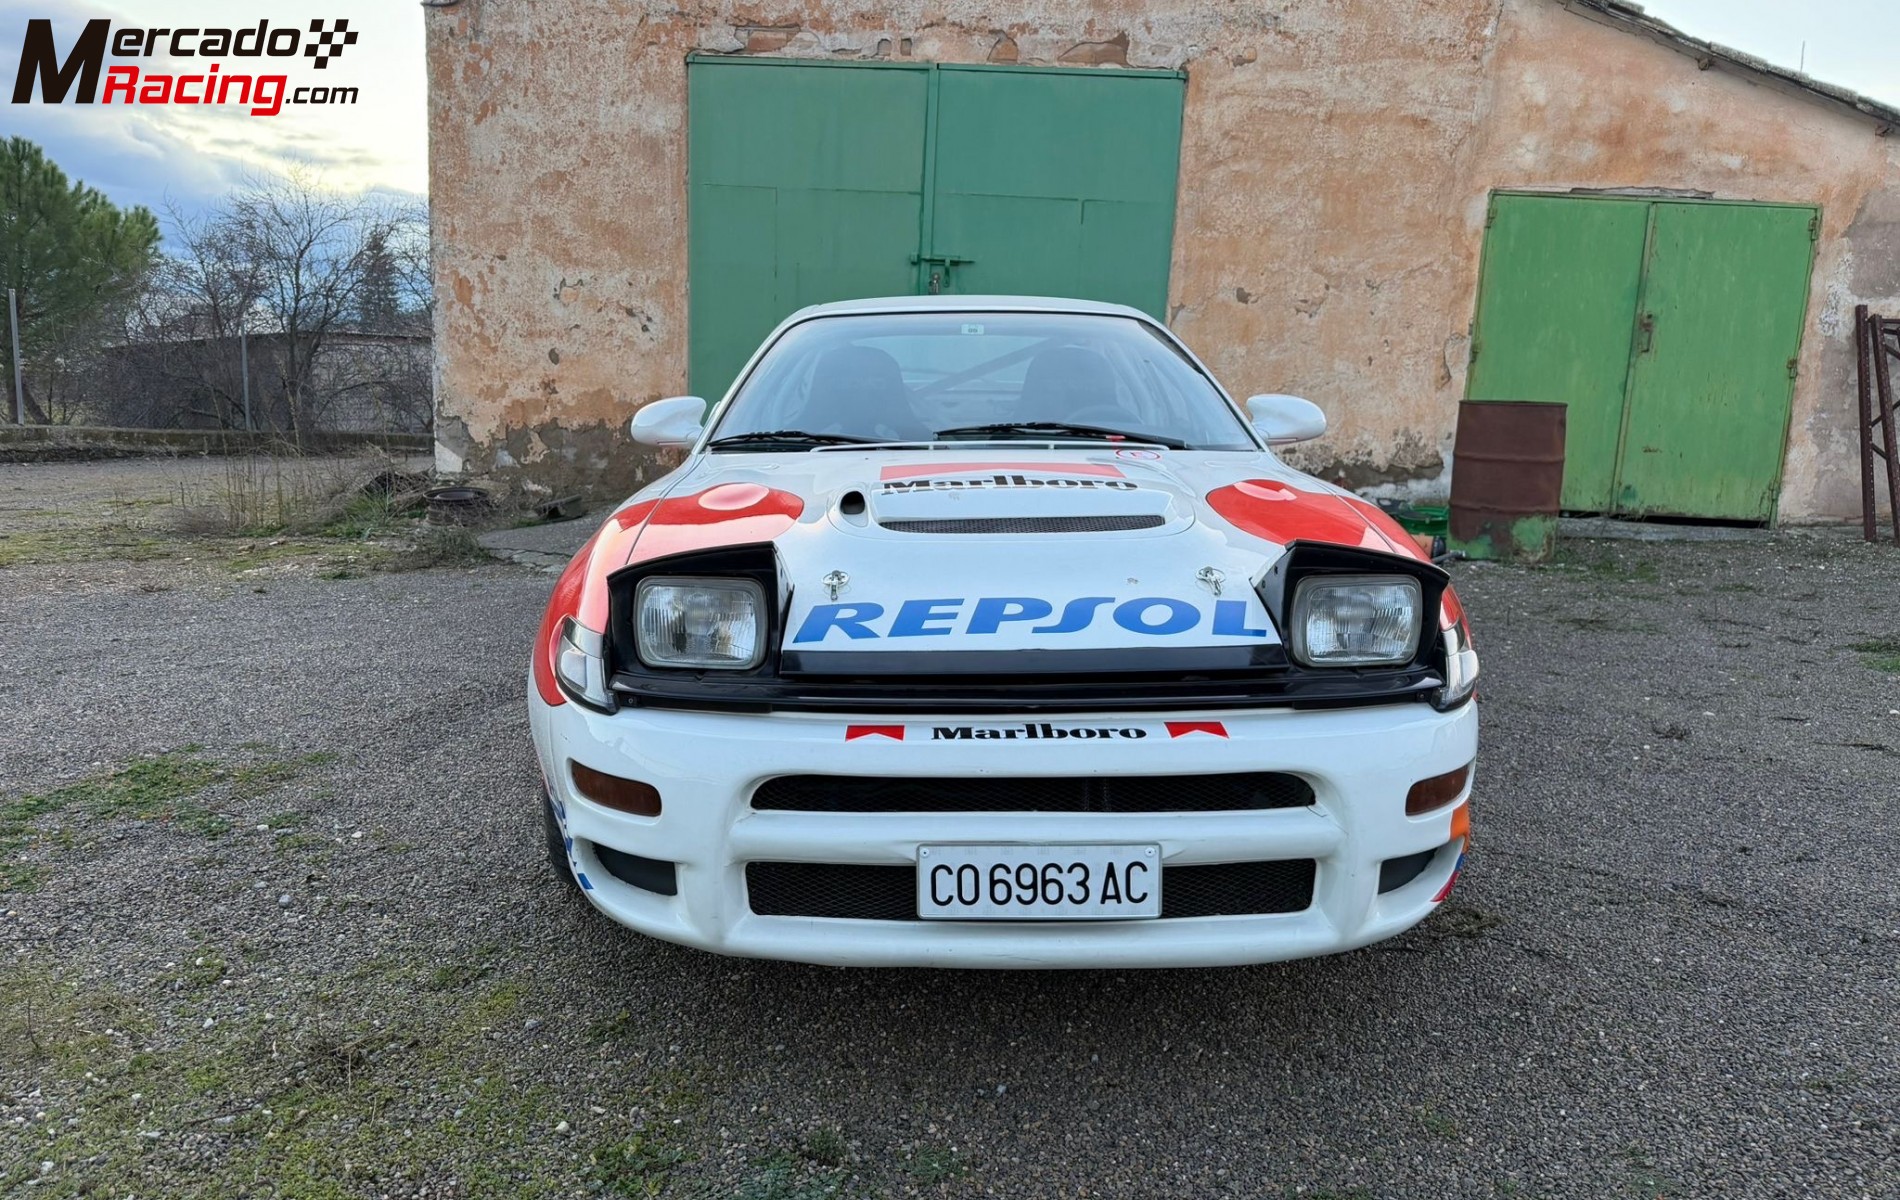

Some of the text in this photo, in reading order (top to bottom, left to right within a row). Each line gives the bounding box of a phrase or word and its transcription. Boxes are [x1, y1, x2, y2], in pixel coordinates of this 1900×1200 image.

[881, 474, 1138, 495] Marlboro
[792, 596, 1267, 644] REPSOL
[931, 723, 1147, 740] Marlboro
